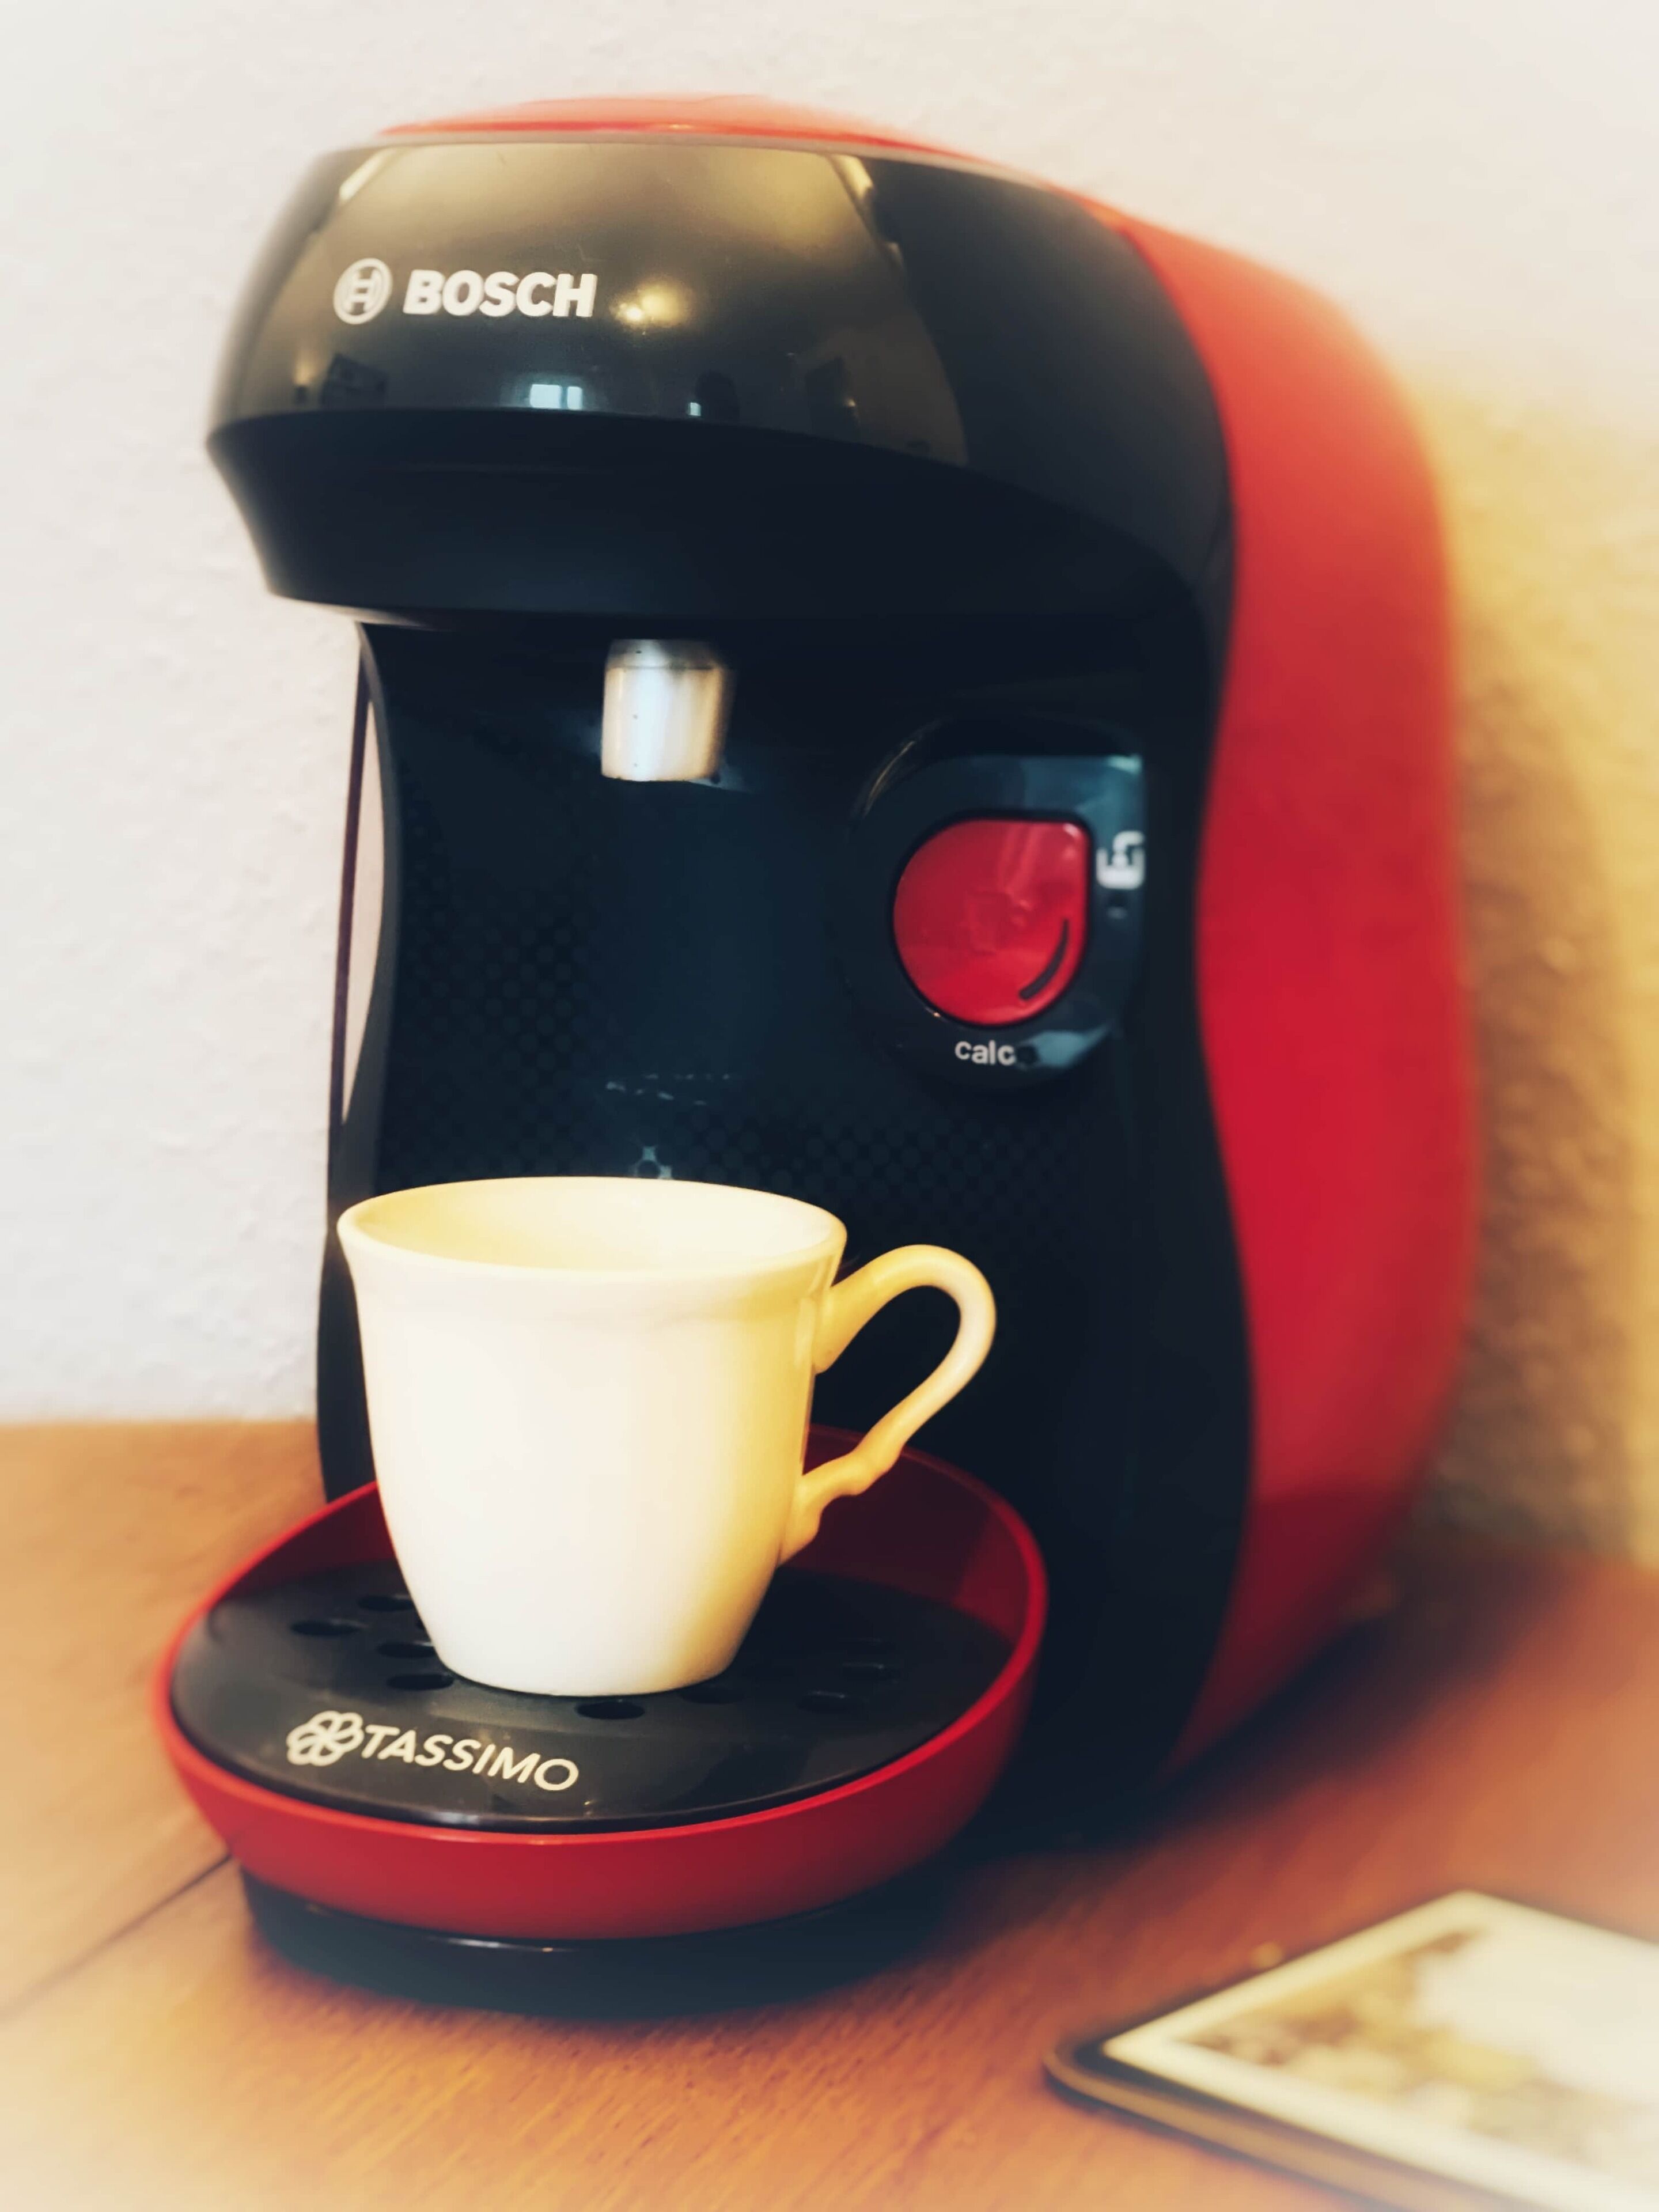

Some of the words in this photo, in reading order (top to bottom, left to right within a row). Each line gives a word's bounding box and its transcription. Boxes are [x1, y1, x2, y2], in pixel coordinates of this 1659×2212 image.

[403, 269, 598, 318] BOSCH
[955, 1040, 1017, 1066] calc
[361, 1724, 579, 1791] TASSIMO
